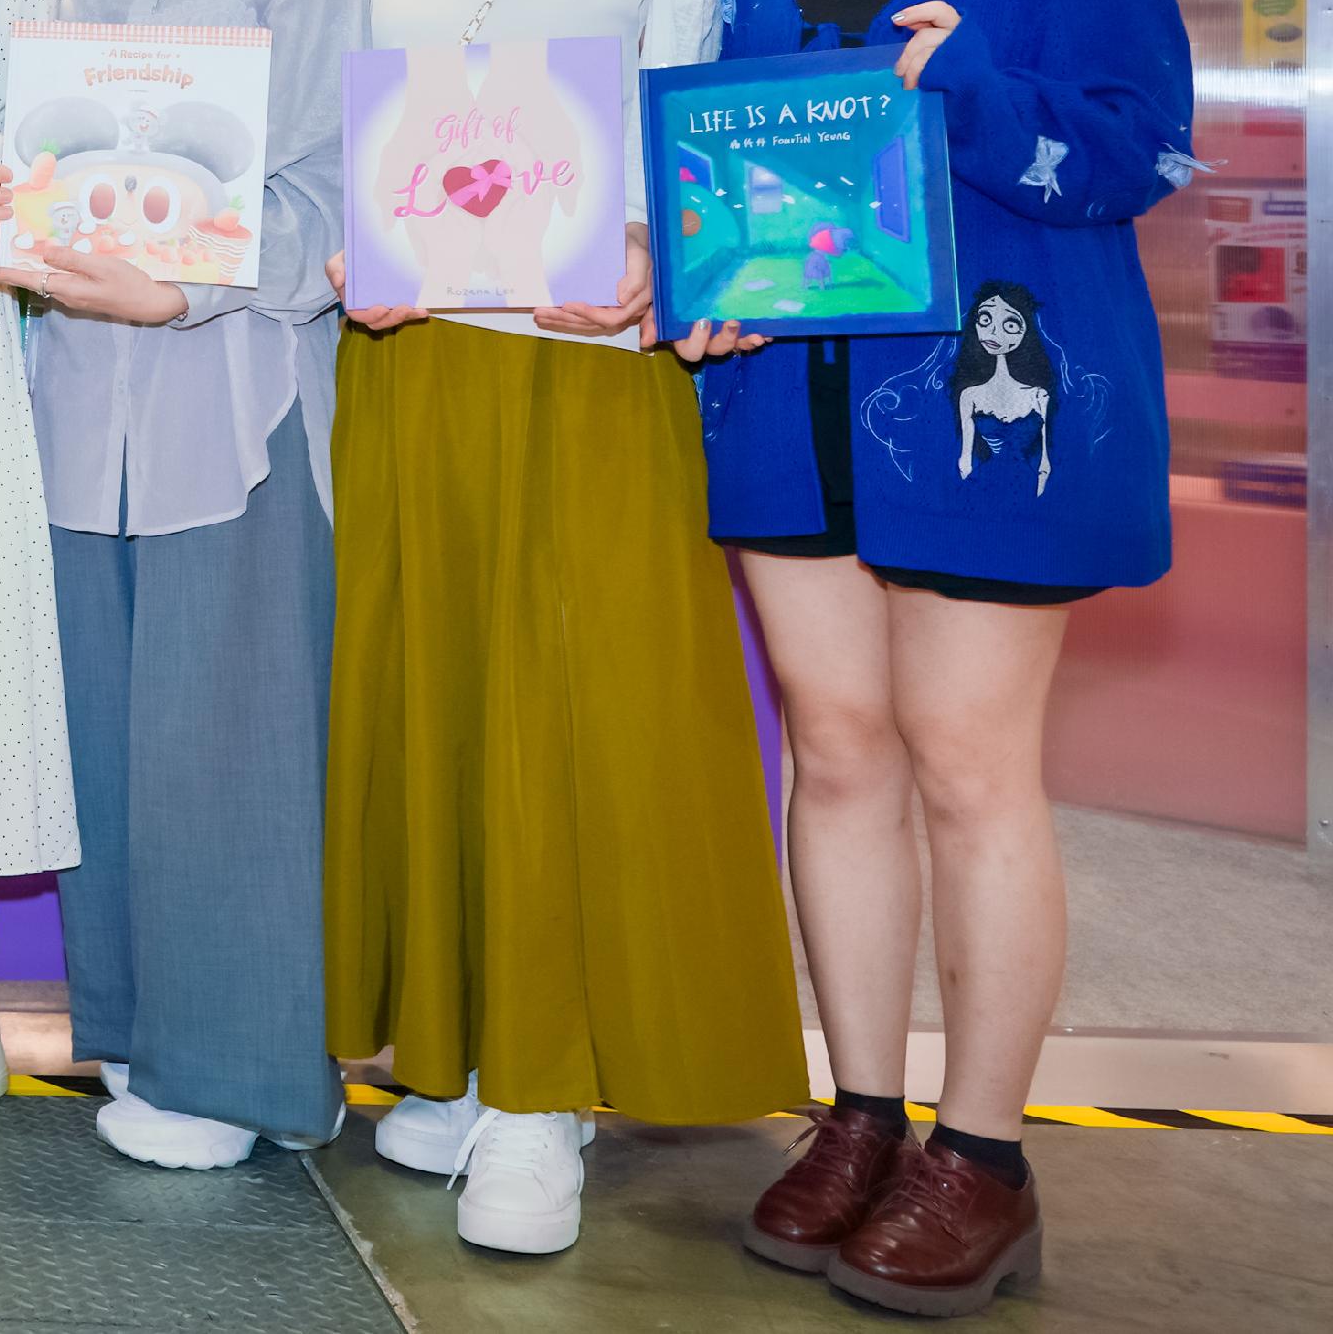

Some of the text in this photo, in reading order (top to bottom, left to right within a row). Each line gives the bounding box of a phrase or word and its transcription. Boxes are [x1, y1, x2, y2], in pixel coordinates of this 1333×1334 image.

[109, 49, 171, 59] A Recipe for
[84, 63, 194, 89] Friendship
[434, 106, 520, 153] Gift of
[689, 109, 737, 134] LIFE
[745, 105, 766, 129] IS
[778, 103, 797, 125] A
